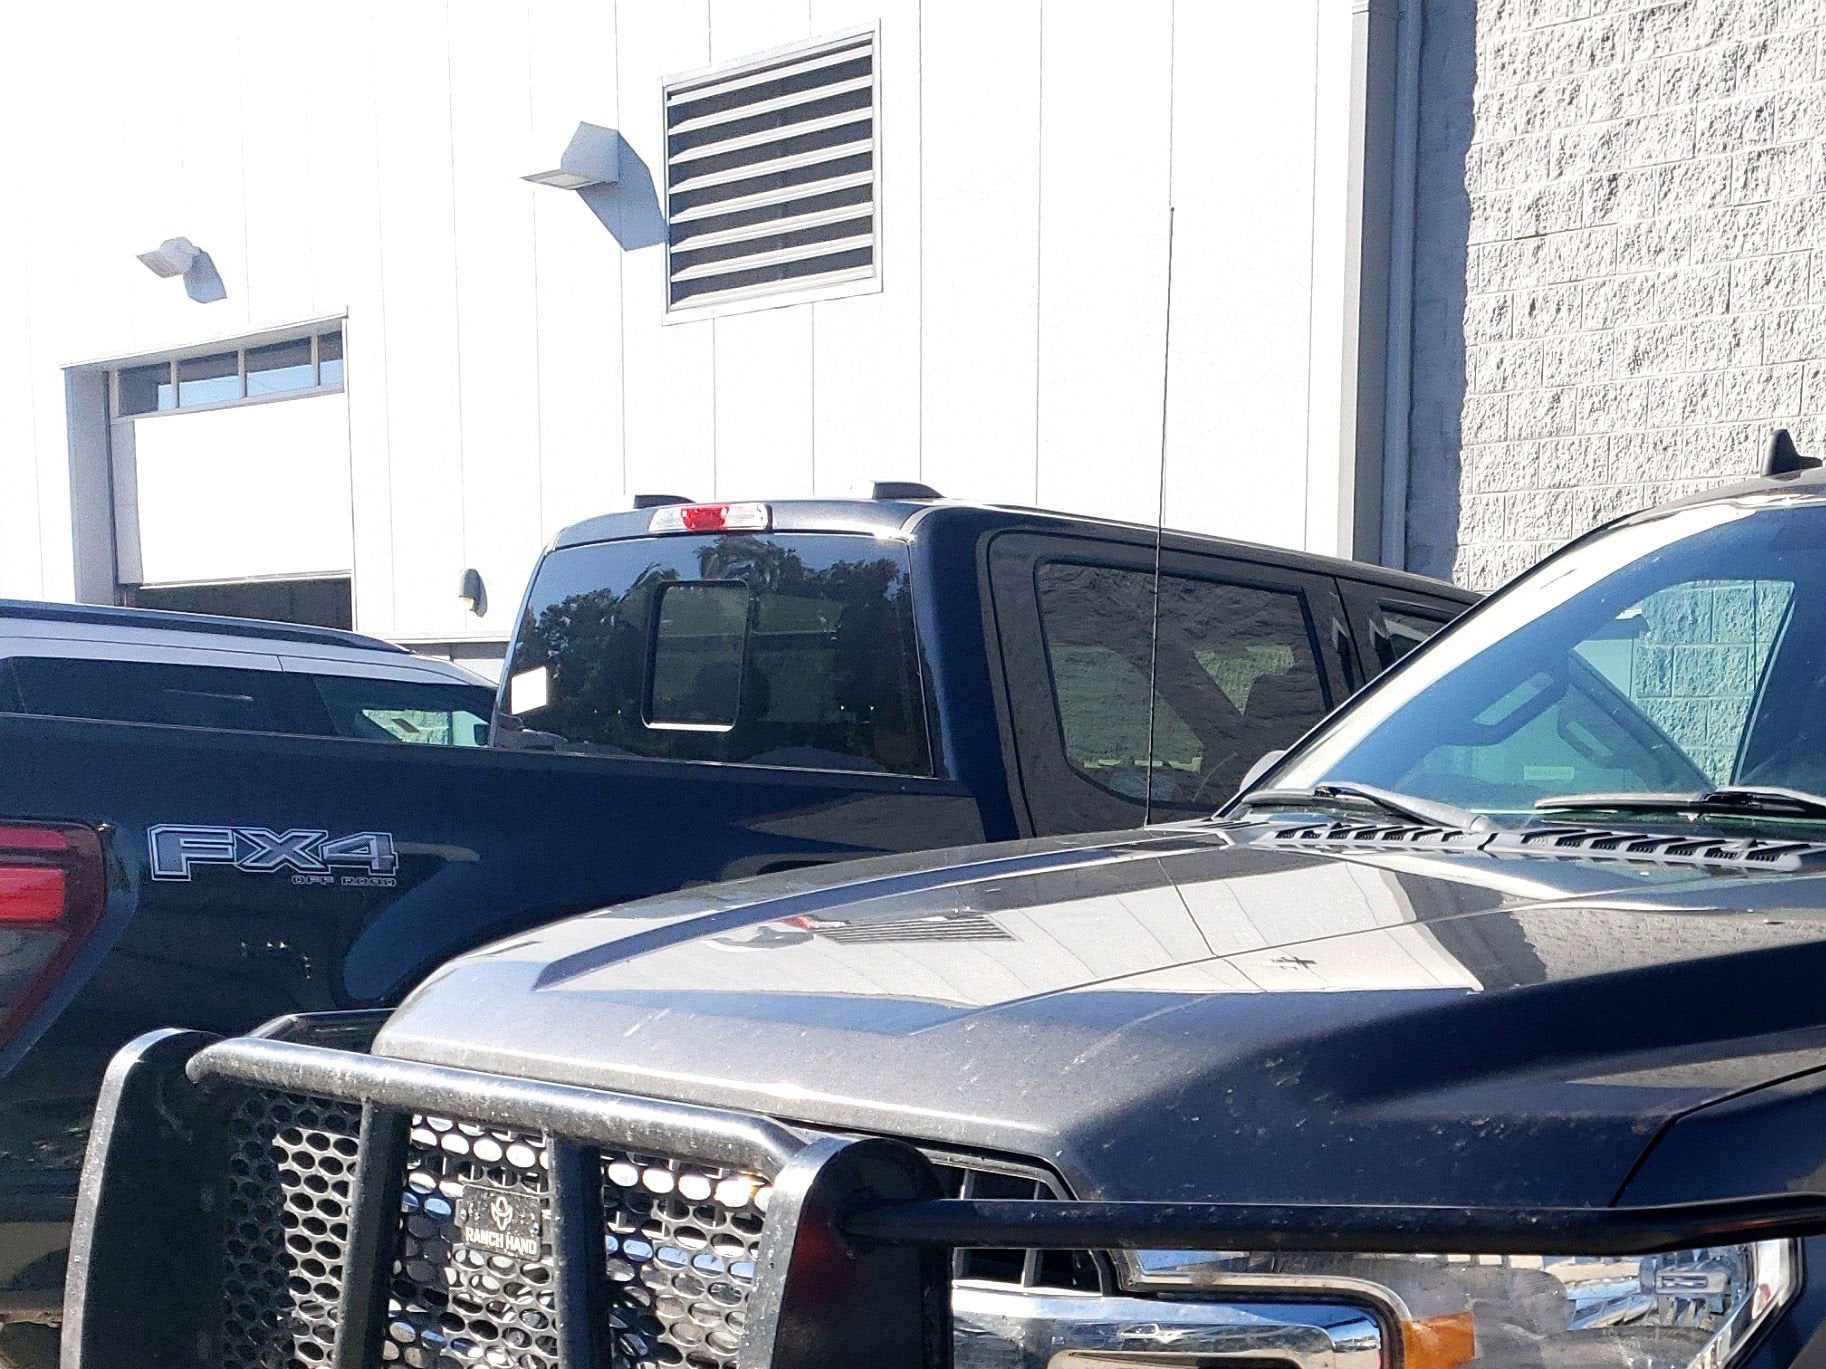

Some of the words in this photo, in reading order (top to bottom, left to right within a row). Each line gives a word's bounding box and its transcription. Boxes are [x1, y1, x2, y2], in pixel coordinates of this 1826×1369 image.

[147, 823, 399, 881] FX4
[291, 875, 334, 885] OFF
[341, 877, 397, 887] ROAD
[465, 1227, 503, 1248] RANCH
[505, 1232, 538, 1254] HAND
